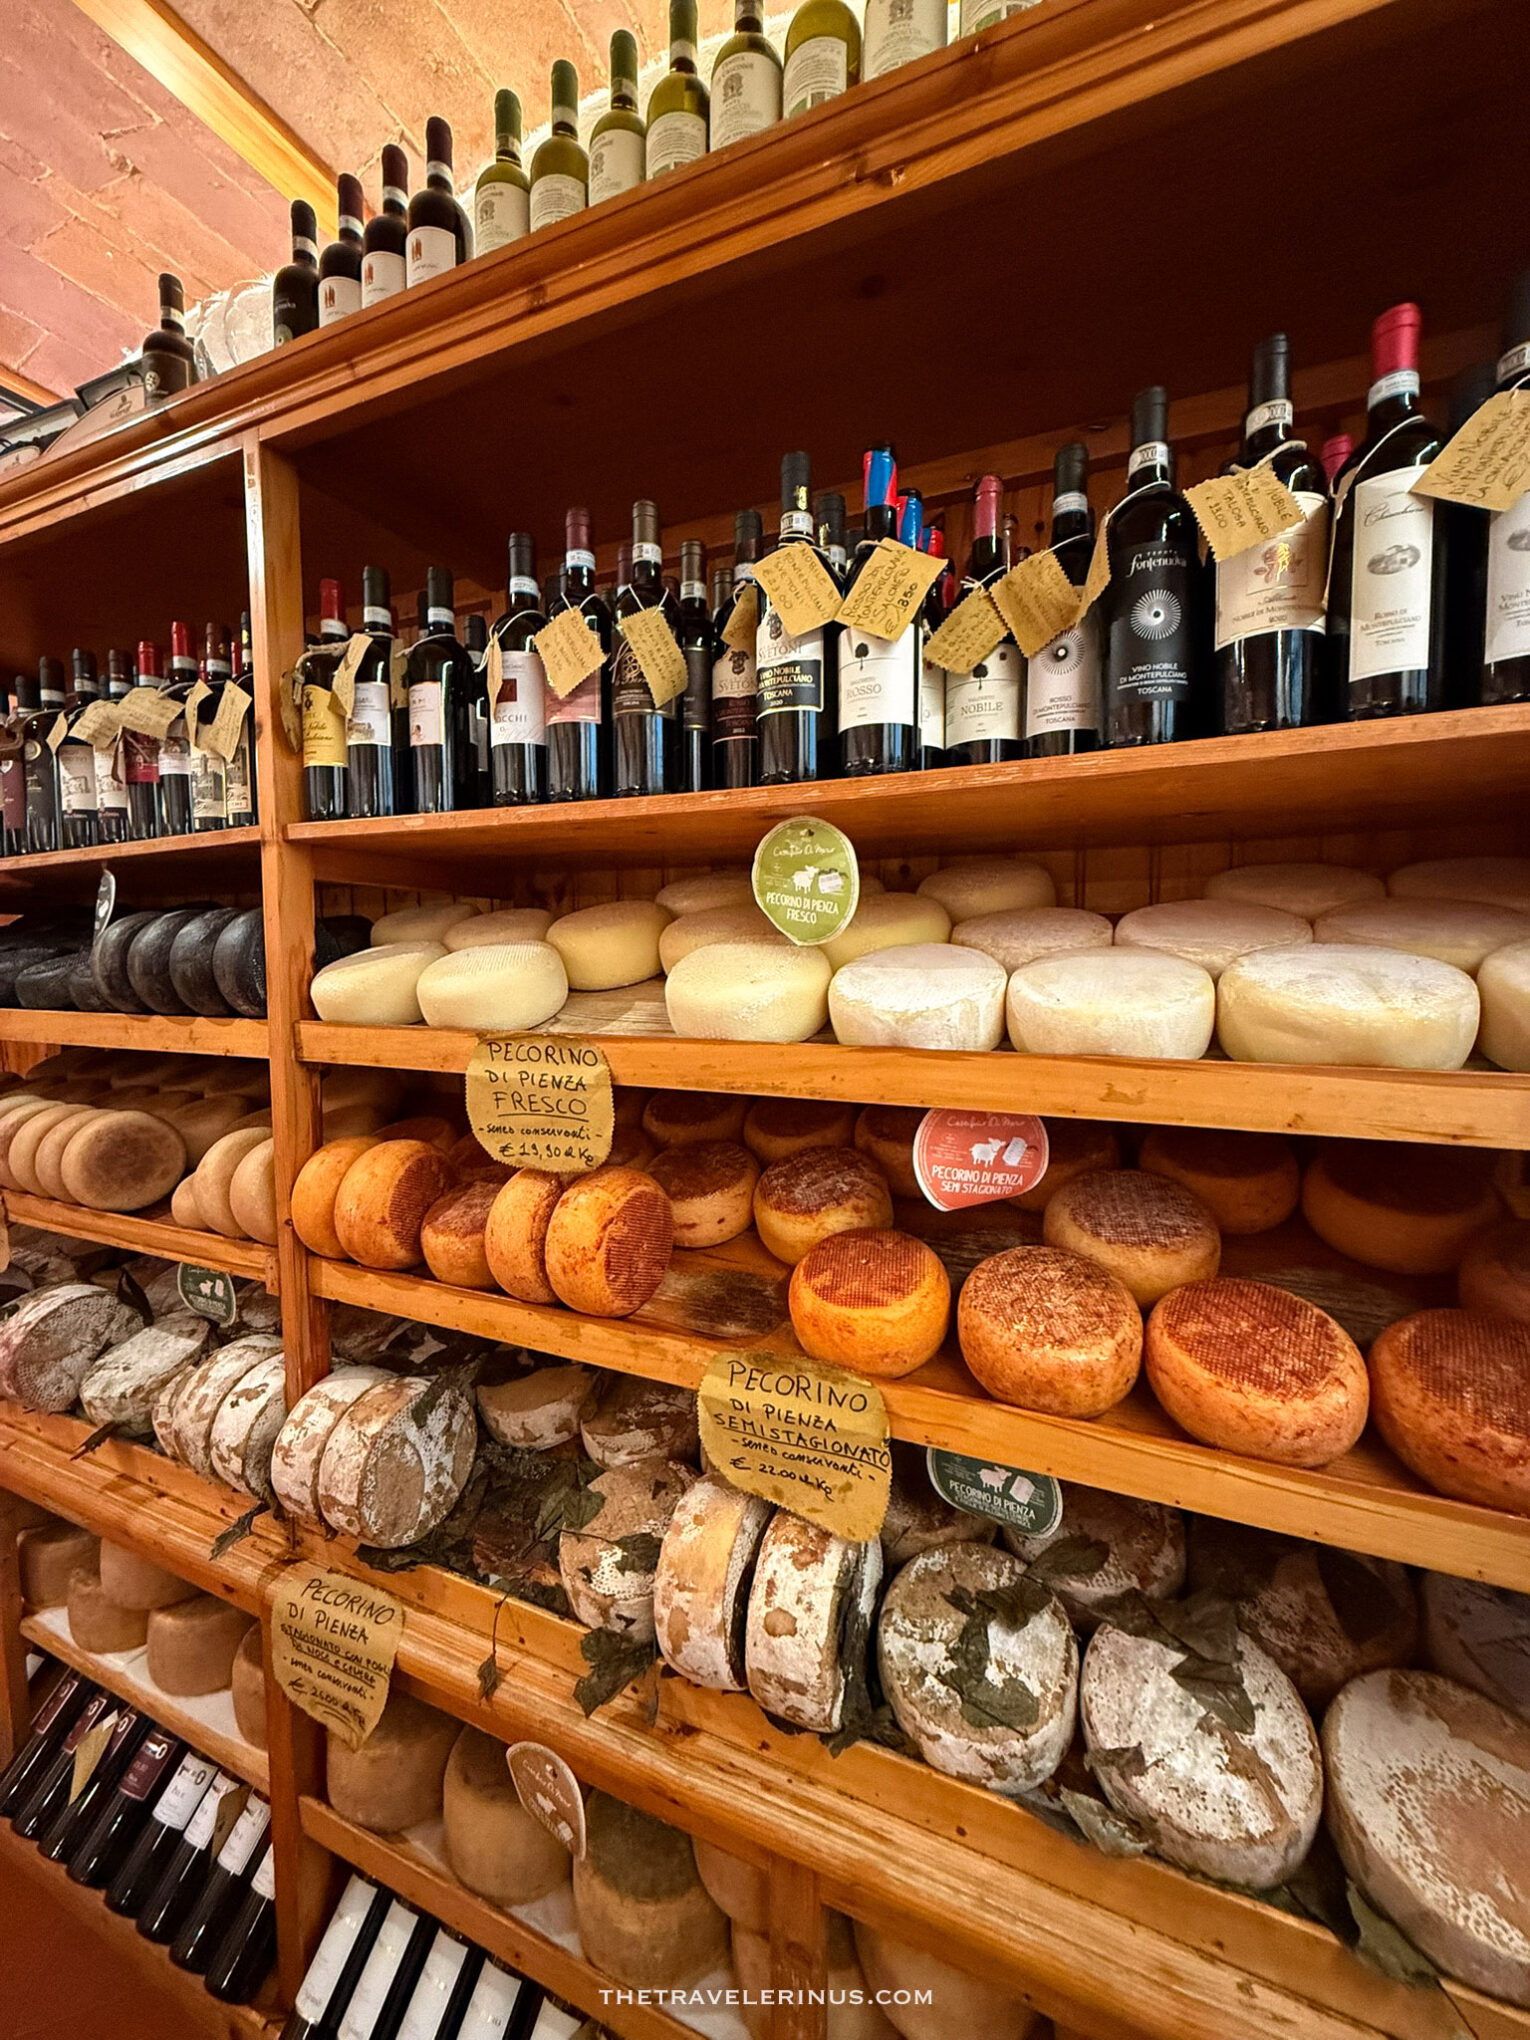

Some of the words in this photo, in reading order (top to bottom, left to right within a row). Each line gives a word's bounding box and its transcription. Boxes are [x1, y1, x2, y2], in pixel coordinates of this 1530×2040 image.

[1128, 670, 1188, 682] MONTEPULCIANO
[1131, 663, 1152, 673] VINO
[1152, 662, 1178, 672] NOBILE
[763, 688, 793, 701] TOSCANA
[1137, 685, 1173, 695] TOSCANA
[960, 702, 1004, 716] NOBILE
[766, 891, 802, 910] PECORINO
[802, 897, 812, 911] DI
[811, 898, 840, 915] PIENZA
[786, 908, 818, 925] FRESCO
[487, 1041, 599, 1067] PECORINO
[484, 1069, 508, 1084] DI
[518, 1070, 588, 1092] PIENZA
[492, 1090, 588, 1116] FRESCO
[520, 1125, 592, 1141] conservanti
[931, 1165, 981, 1184] PECORINO
[981, 1171, 992, 1184] DI
[991, 1172, 1023, 1186] PIENZA
[940, 1180, 960, 1193] SEMI
[960, 1182, 1014, 1196] STAGIONATO
[727, 1360, 868, 1413] PECORINO
[729, 1398, 751, 1414] DI
[761, 1403, 838, 1433] PIENZA
[713, 1411, 891, 1468] SEMISTAGIONATO
[781, 1450, 863, 1480] conservanti
[949, 1479, 992, 1504] PECORINO
[993, 1496, 1003, 1508] DI
[1003, 1499, 1037, 1520] PIENZA
[300, 1577, 396, 1626] PECORINO
[286, 1601, 305, 1620] DI
[314, 1609, 370, 1646] PIENZA
